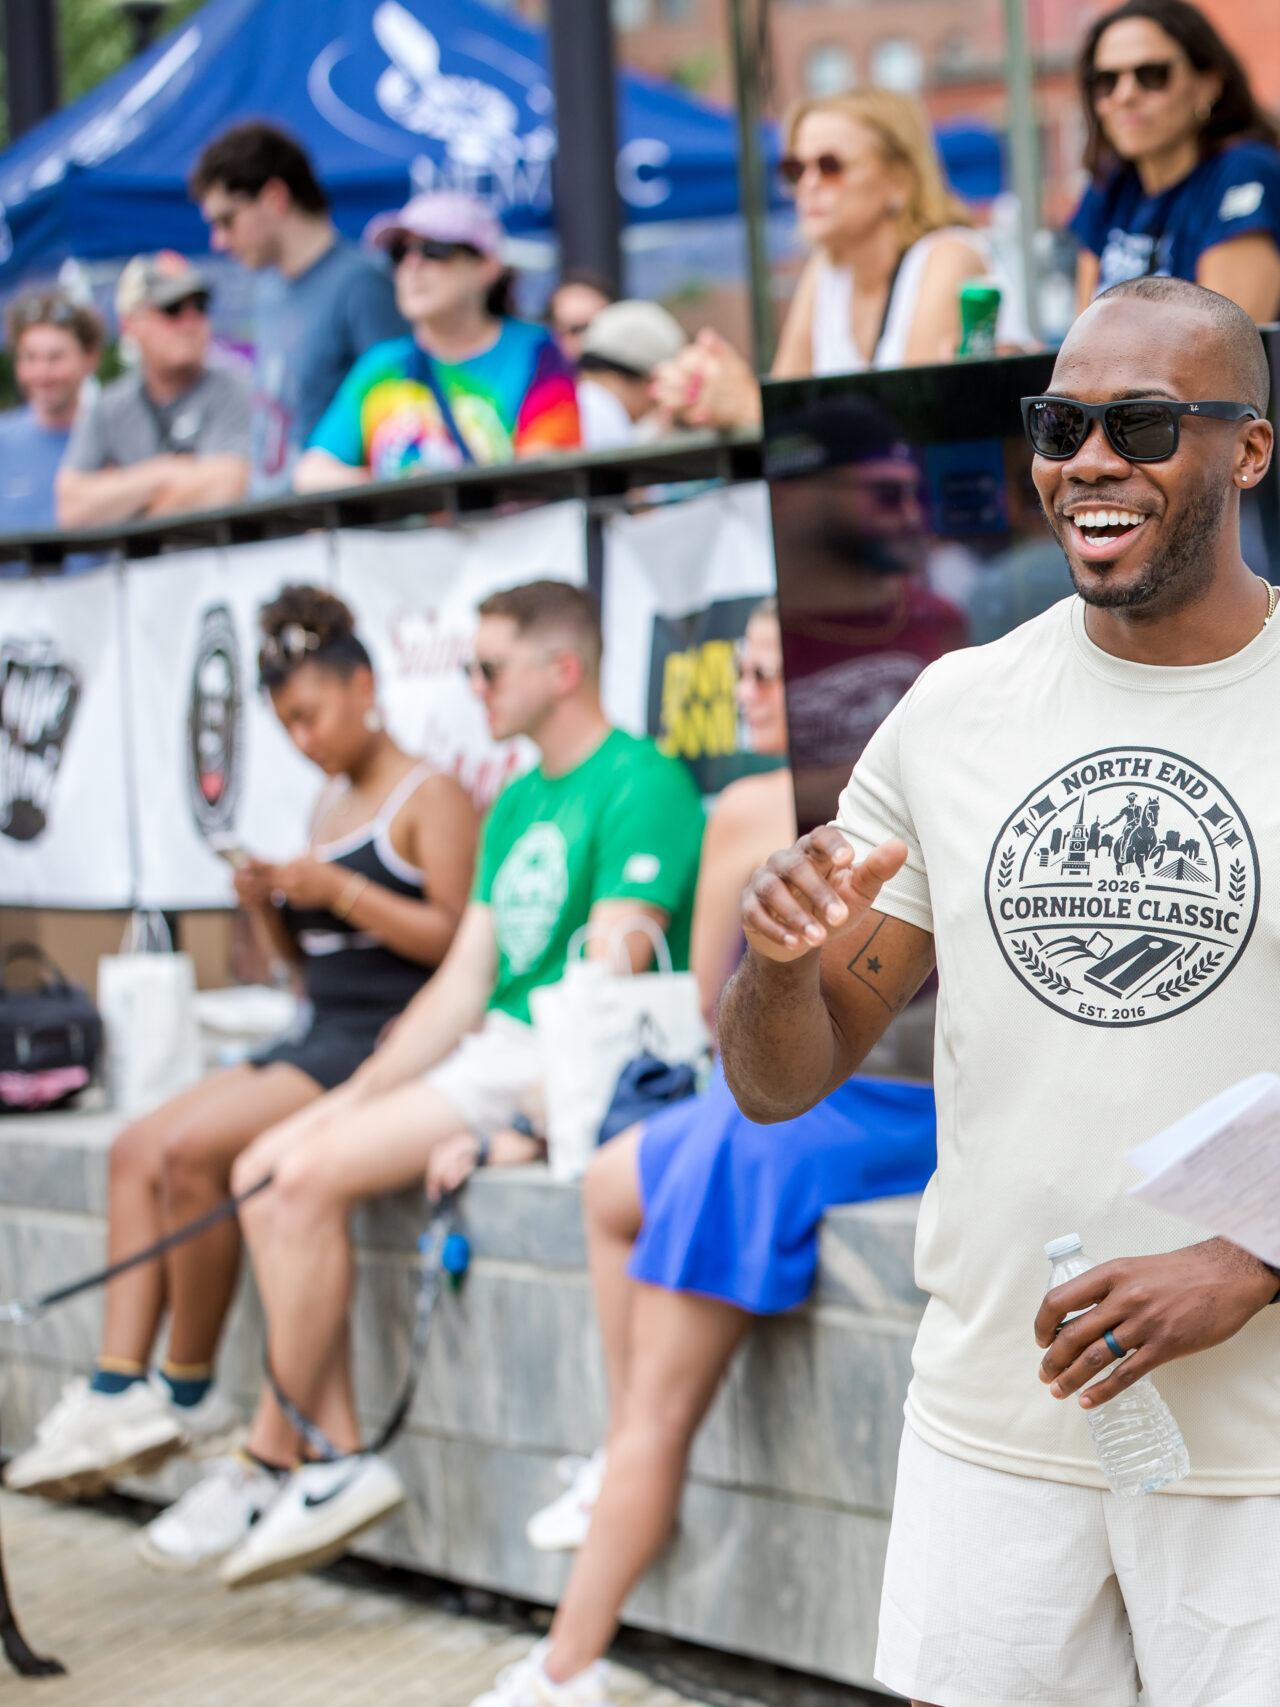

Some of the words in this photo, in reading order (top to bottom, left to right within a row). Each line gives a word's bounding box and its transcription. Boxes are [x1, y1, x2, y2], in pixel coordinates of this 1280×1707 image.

[1060, 758, 1153, 796] NORTH
[1156, 762, 1209, 800] END
[1097, 879, 1141, 893] 2026
[1000, 897, 1132, 921] CORNHOLE
[1138, 899, 1240, 934] CLASSIC
[1077, 1003, 1107, 1019] EST.
[1111, 1006, 1146, 1020] 2016
